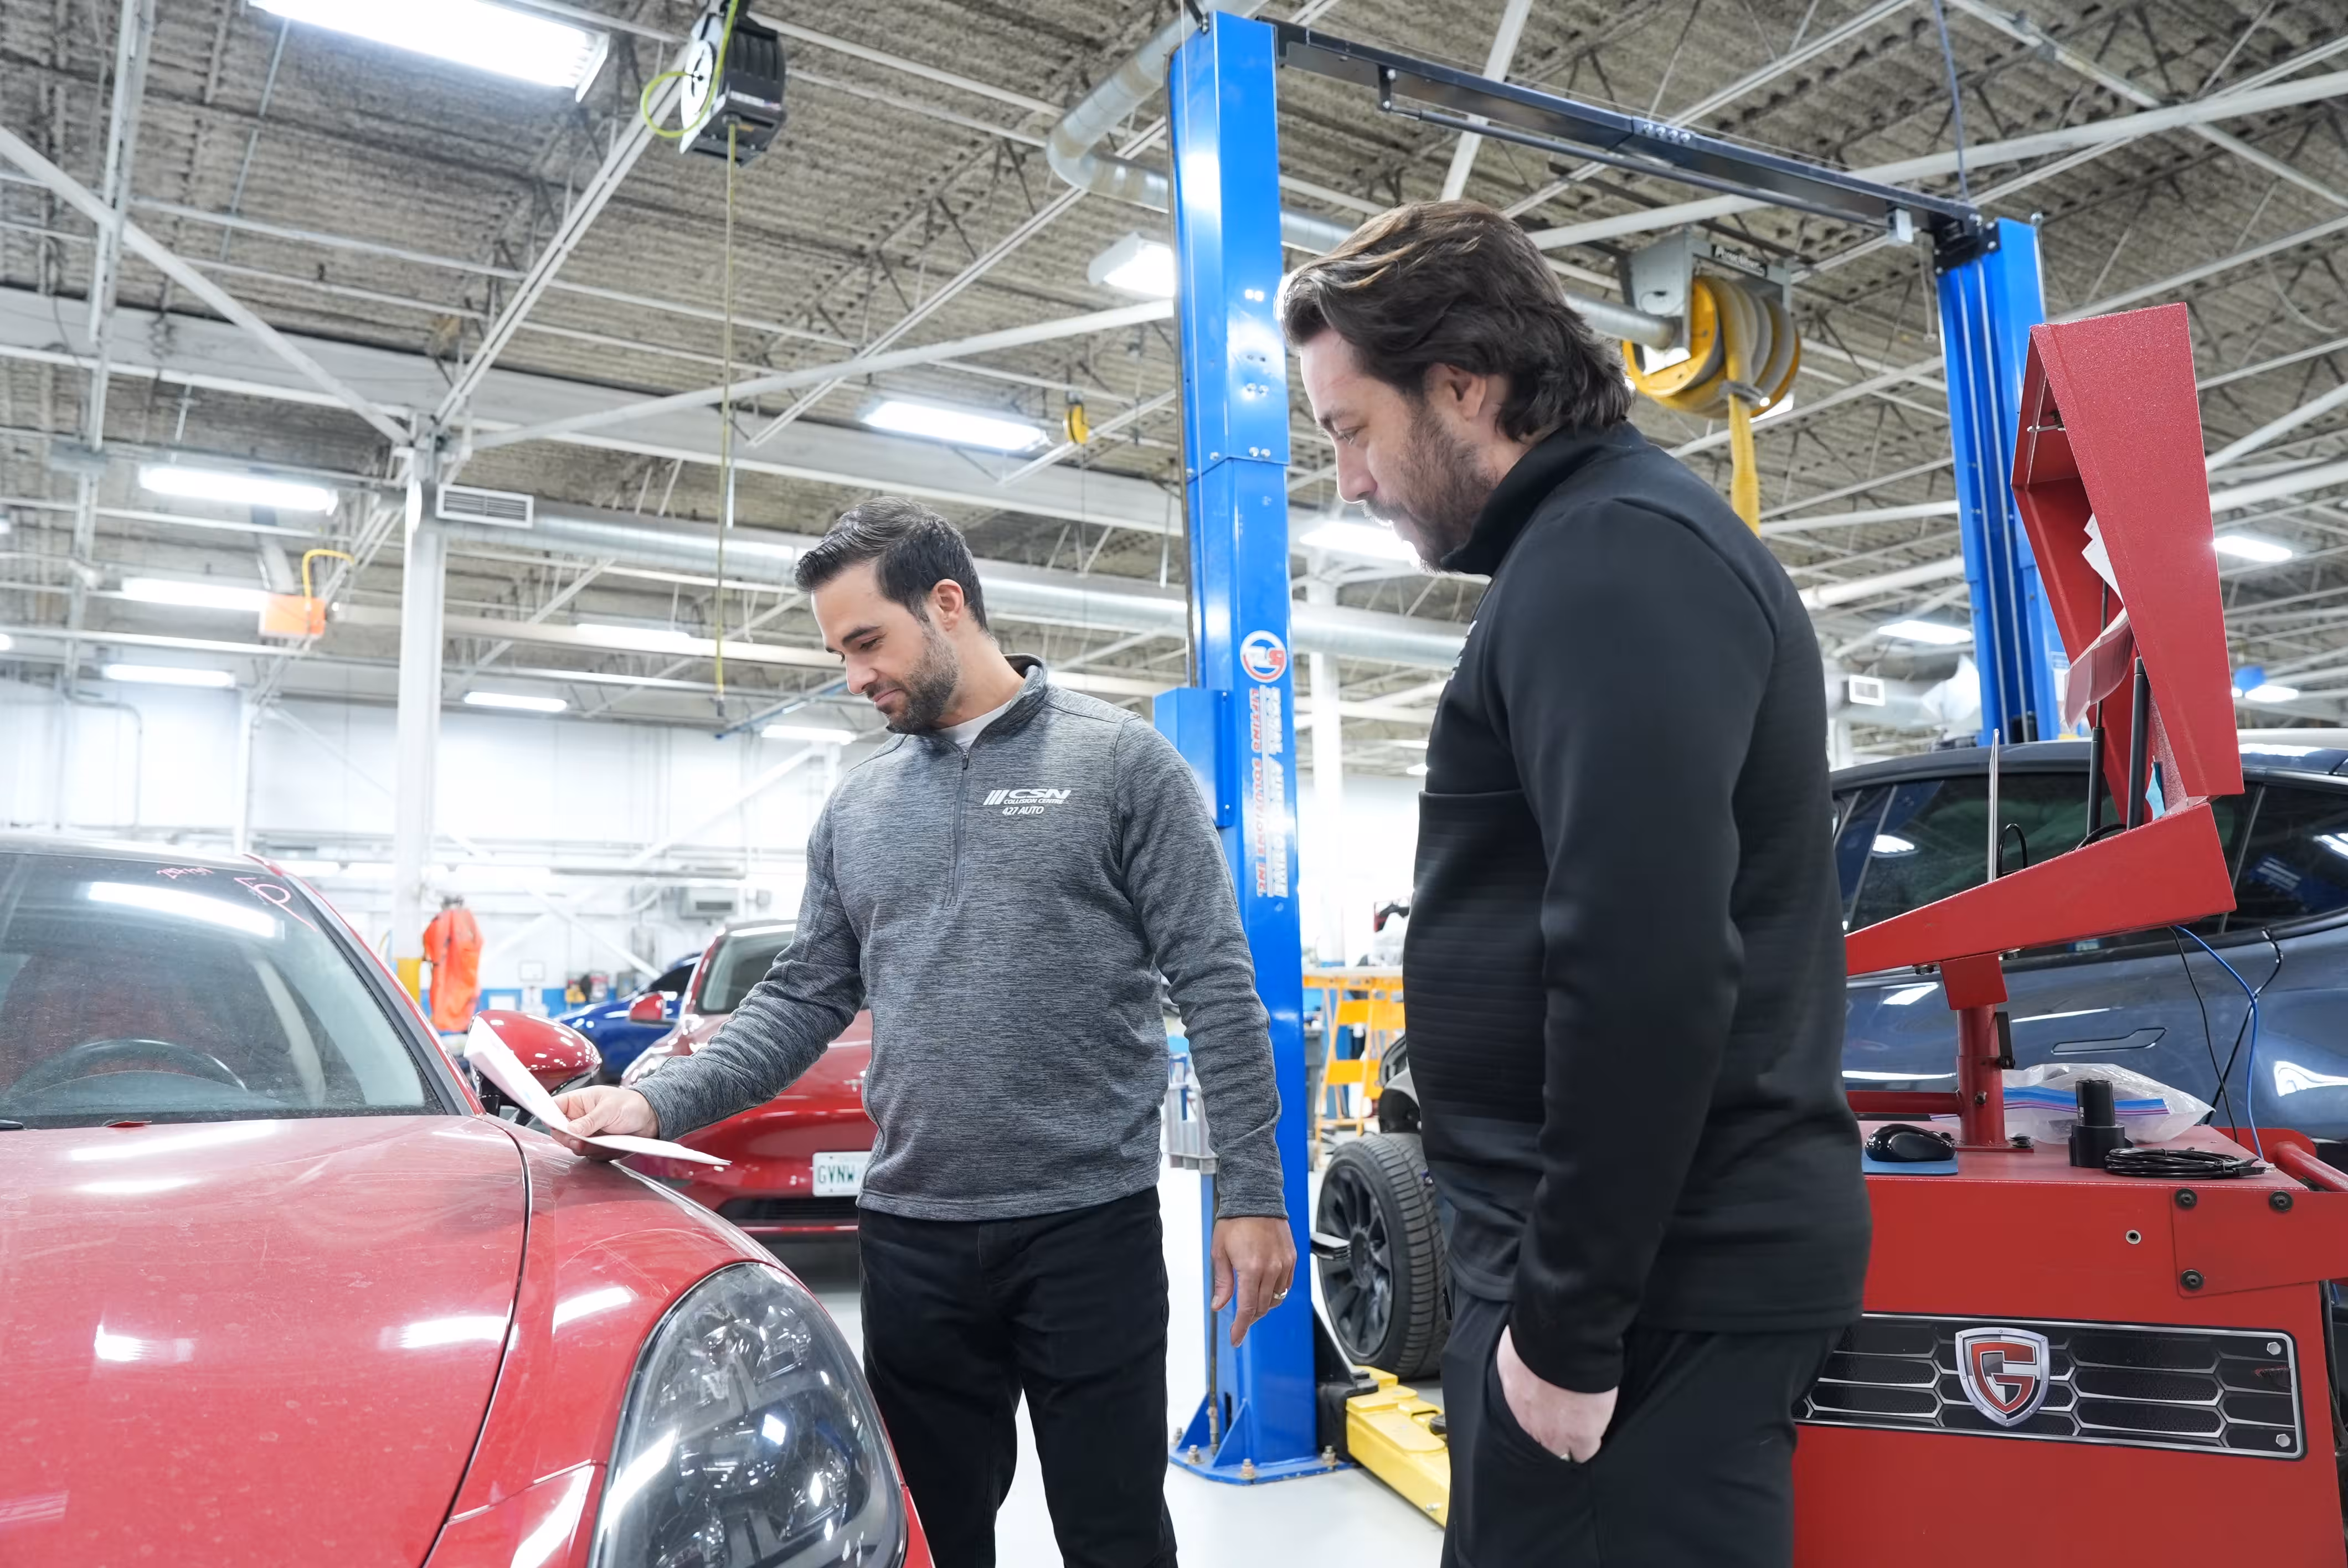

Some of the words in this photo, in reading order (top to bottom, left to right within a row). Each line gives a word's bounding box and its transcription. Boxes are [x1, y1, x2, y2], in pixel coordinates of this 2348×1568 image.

[1266, 688, 1282, 754] TOTAL
[1002, 806, 1019, 816] 427
[1018, 806, 1044, 815] AUTO
[1009, 788, 1072, 799] CSN
[1252, 688, 1261, 751] LIFTING
[1258, 863, 1266, 895] INC.
[1269, 757, 1288, 896] AUTOTIVE
[1970, 1340, 2037, 1415] G
